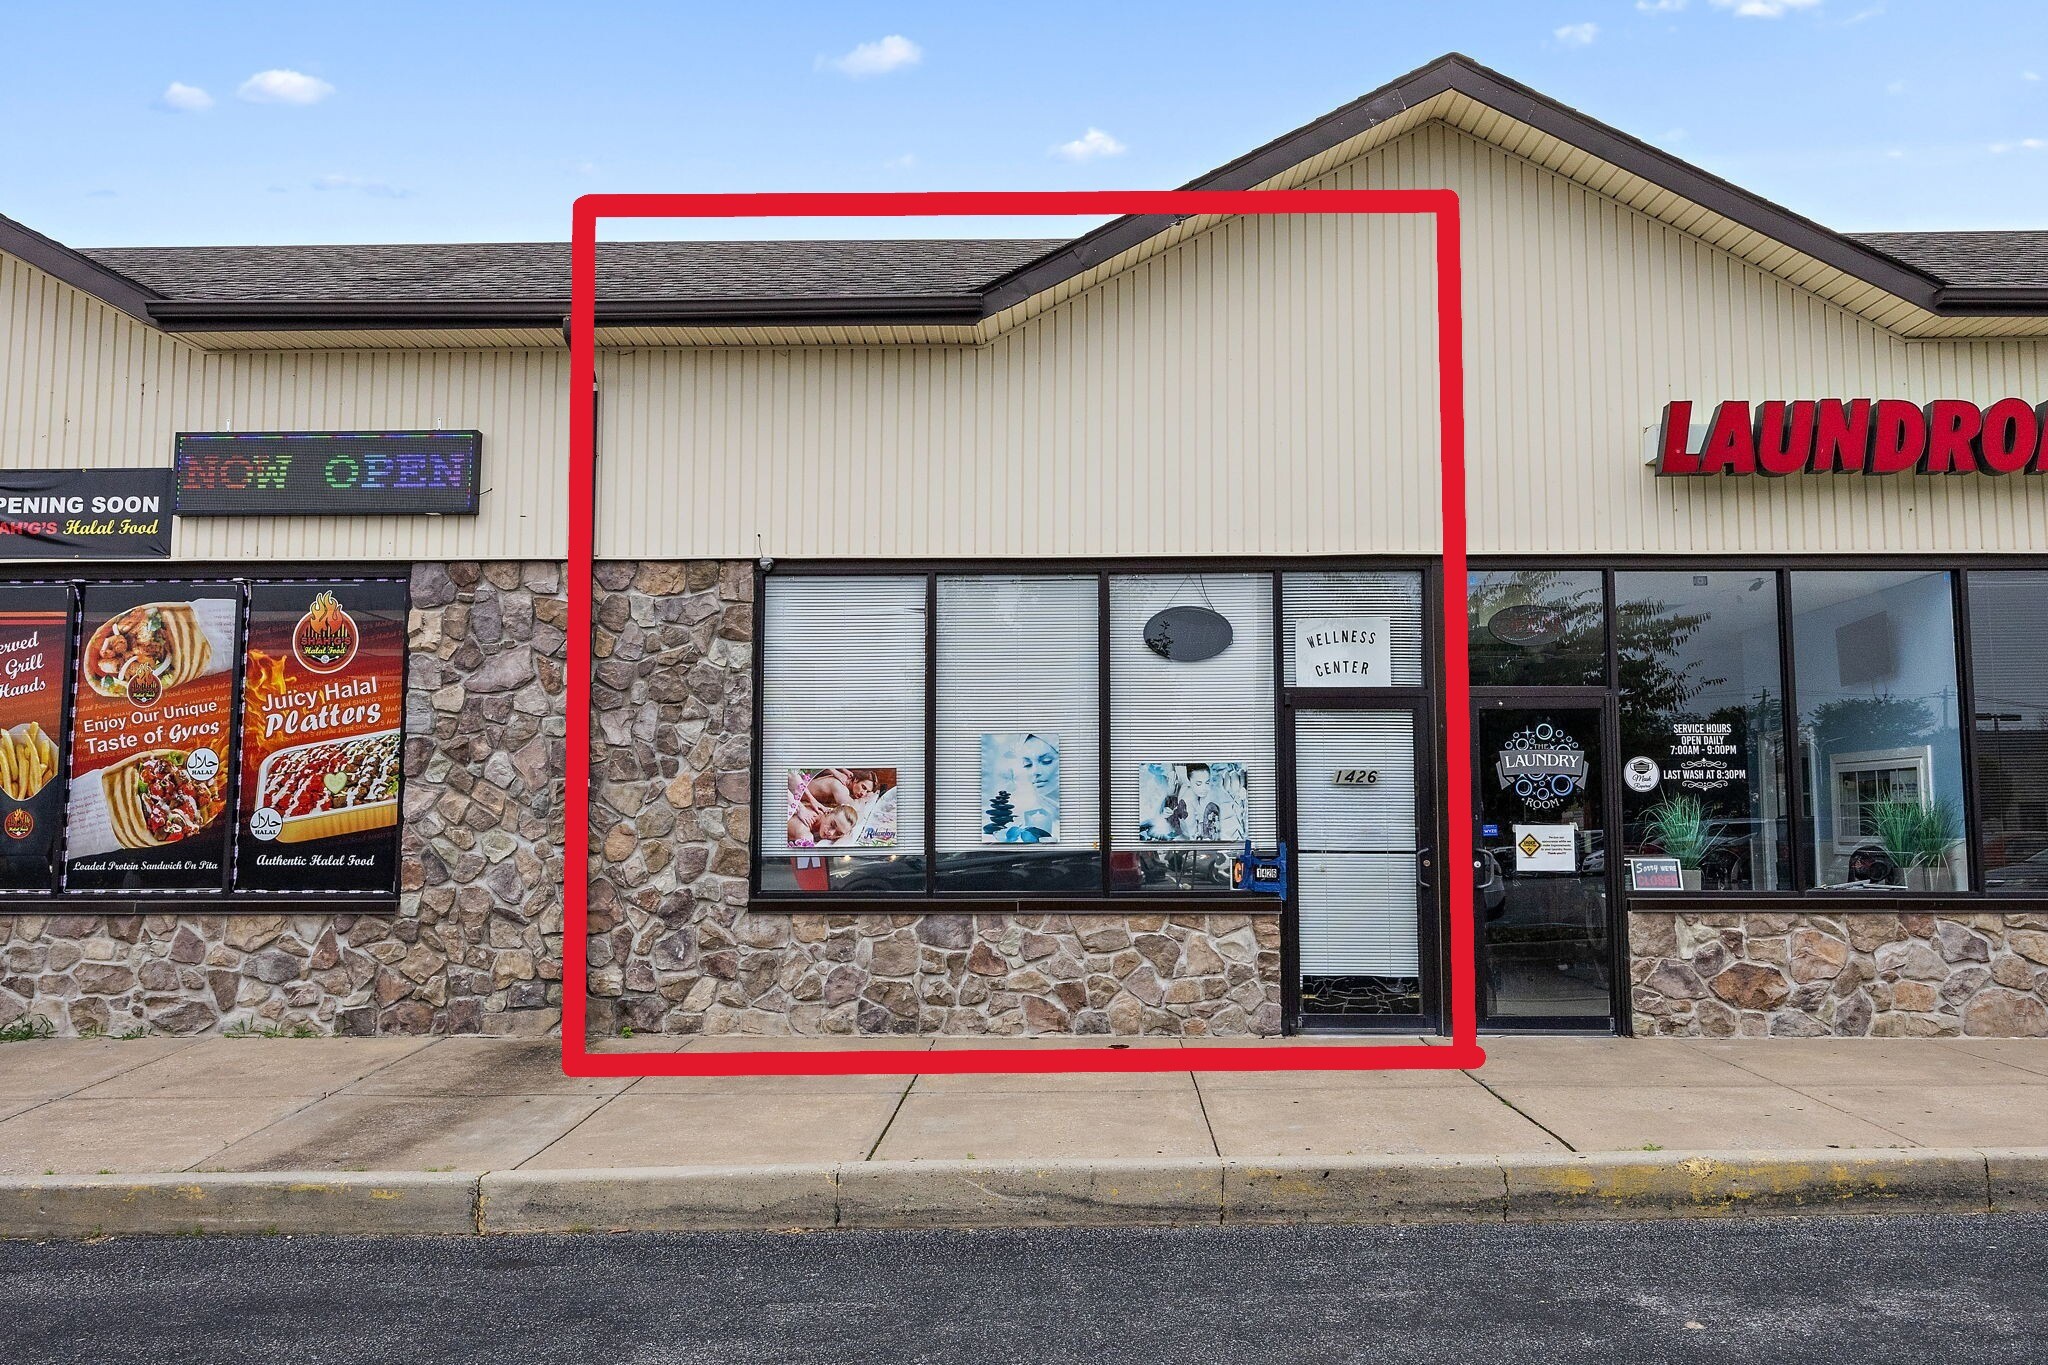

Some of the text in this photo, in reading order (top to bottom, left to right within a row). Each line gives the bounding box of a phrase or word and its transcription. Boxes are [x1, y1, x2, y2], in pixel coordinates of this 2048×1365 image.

[1656, 397, 2048, 475] LAUNDRO
[181, 454, 465, 489] NOW OPEN
[91, 496, 160, 514] SOON
[62, 519, 115, 535] Halal
[118, 519, 159, 535] Food
[1306, 629, 1376, 649] WELLNESS
[303, 646, 347, 654] Halal Food
[5, 653, 44, 680] Grill
[1315, 660, 1369, 677] CENTER
[261, 690, 318, 712] Juicy
[324, 676, 378, 701] Halal
[83, 717, 126, 733] Enjoy
[131, 710, 160, 725] Our
[163, 701, 218, 720] Unique
[265, 703, 381, 738] Platters
[1673, 723, 1732, 733] SERVICE HOURS
[84, 732, 138, 754] Taste
[143, 726, 163, 744] of
[169, 721, 220, 744] Gyros
[1681, 736, 1725, 745] OPEN DAILY
[1670, 745, 1700, 755] 7:00AM
[1707, 745, 1737, 755] 9:00PM
[1505, 754, 1580, 768] LAUNDRY
[1335, 770, 1378, 784] 1426
[1663, 769, 1746, 779] LAST WASH AT 8:30PM
[1526, 797, 1560, 809] ROOM
[72, 860, 218, 871] Loaded Protein Sandwich On Pita
[256, 854, 375, 866] Authentic Halal Food
[1636, 863, 1659, 873] Sorry
[1637, 875, 1678, 887] CLOSED
